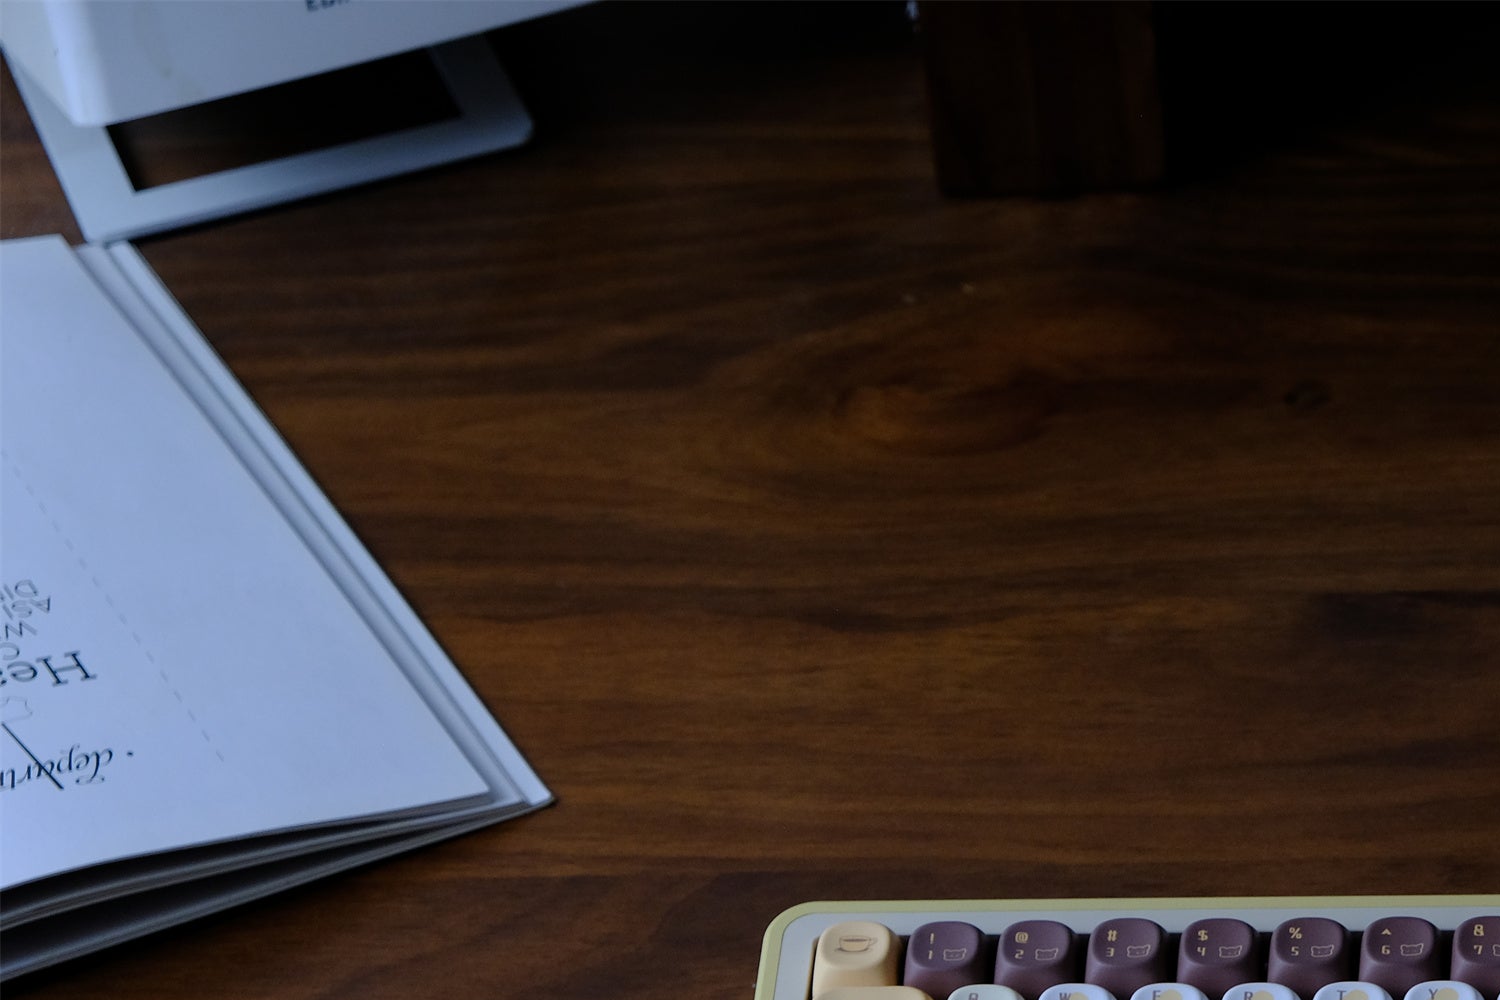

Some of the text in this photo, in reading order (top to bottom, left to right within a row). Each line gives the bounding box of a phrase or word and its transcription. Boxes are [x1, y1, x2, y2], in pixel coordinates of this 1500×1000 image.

[1015, 950, 1024, 959] 2
[1106, 947, 1115, 957] 3
[1197, 947, 1206, 956] 4
[1291, 947, 1299, 956] 5
[1381, 945, 1390, 955] 6
[1473, 945, 1482, 955] 7
[1428, 989, 1438, 1000] Y
